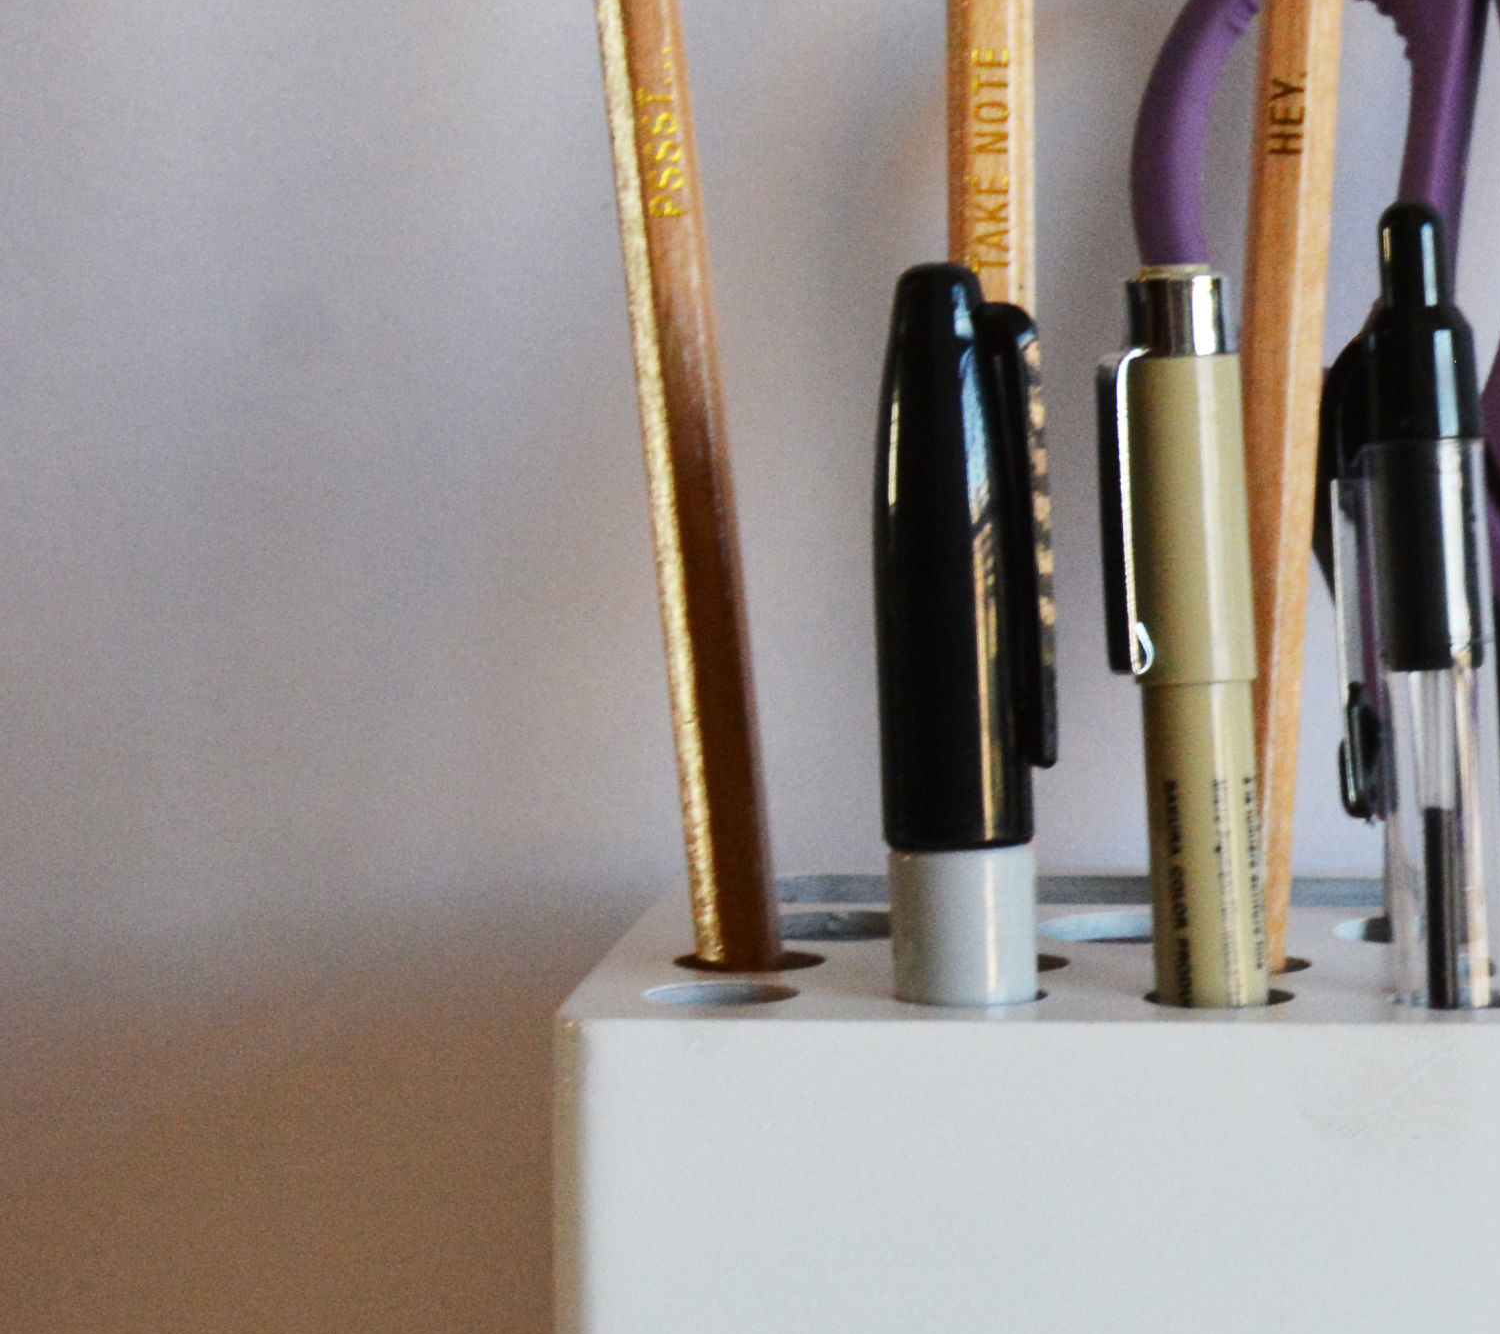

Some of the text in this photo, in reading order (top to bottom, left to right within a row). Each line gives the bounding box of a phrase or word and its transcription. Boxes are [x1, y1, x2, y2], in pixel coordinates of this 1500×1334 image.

[970, 47, 1011, 274] TAKE NOTE
[1267, 71, 1307, 156] HEY.
